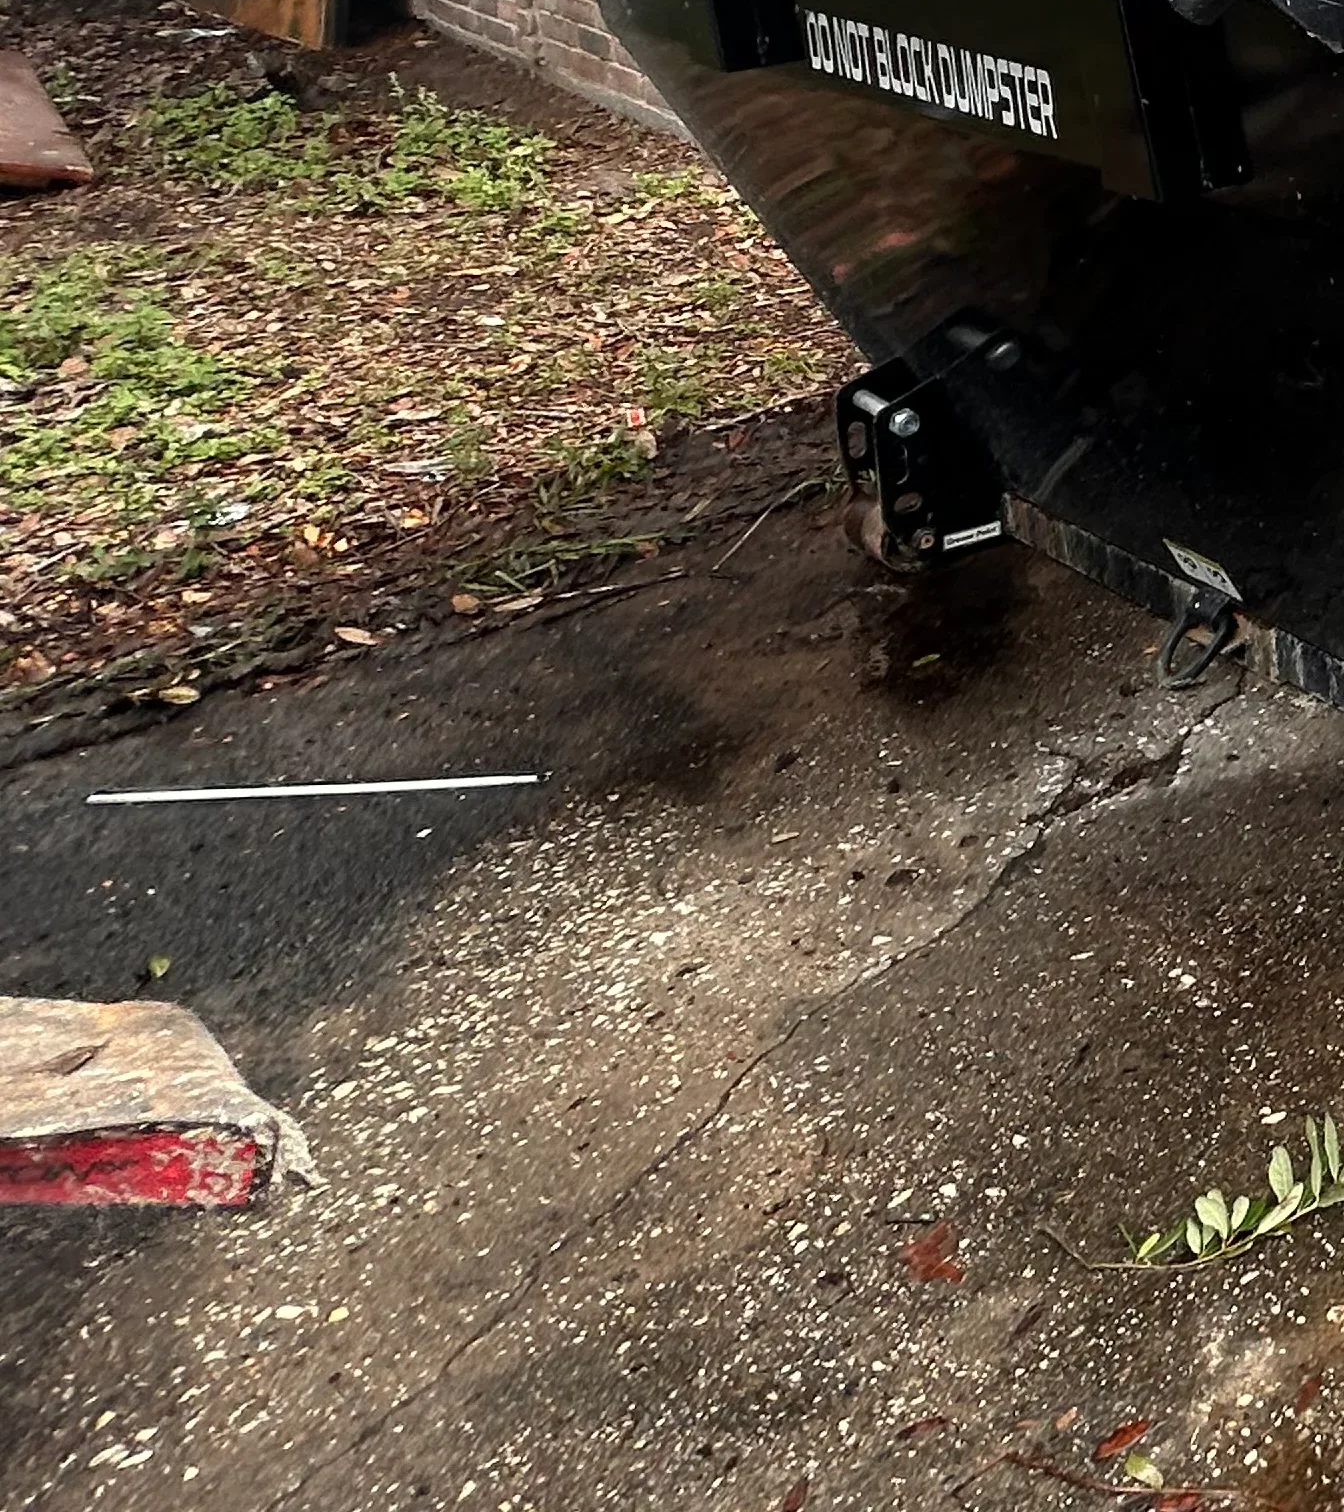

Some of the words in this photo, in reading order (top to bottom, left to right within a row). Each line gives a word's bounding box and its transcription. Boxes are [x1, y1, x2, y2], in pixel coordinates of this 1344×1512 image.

[805, 10, 834, 74] DO
[832, 16, 871, 86] NOT
[872, 26, 940, 105] BLOCK
[936, 42, 1058, 140] DUMPSTER
